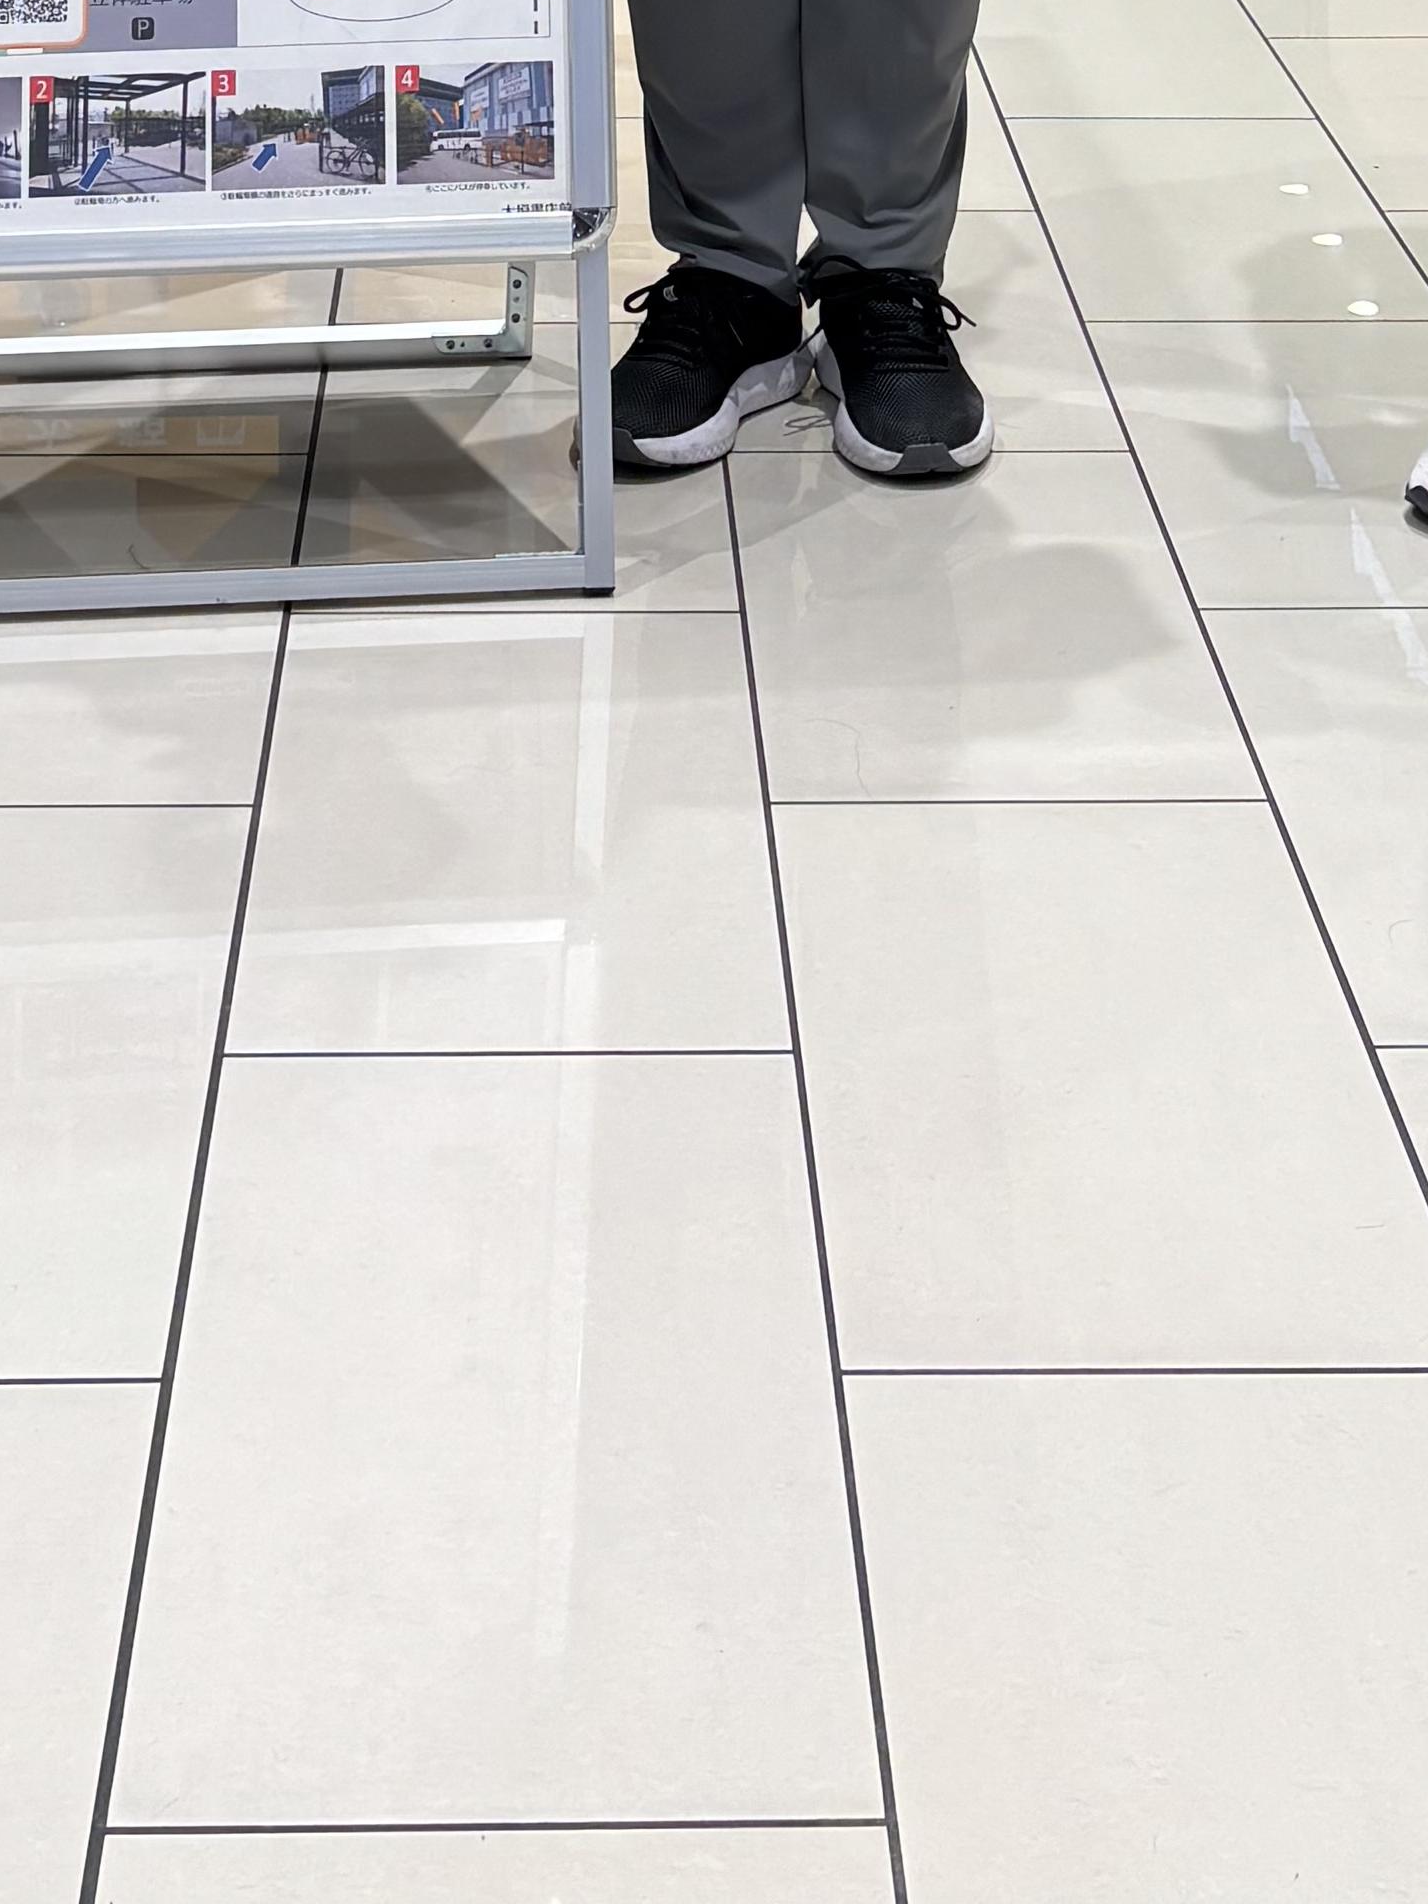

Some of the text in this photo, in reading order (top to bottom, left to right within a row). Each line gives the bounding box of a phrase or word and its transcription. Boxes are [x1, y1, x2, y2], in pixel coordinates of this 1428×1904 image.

[218, 74, 230, 92] 3
[400, 69, 415, 87] 4
[35, 80, 49, 98] 2
